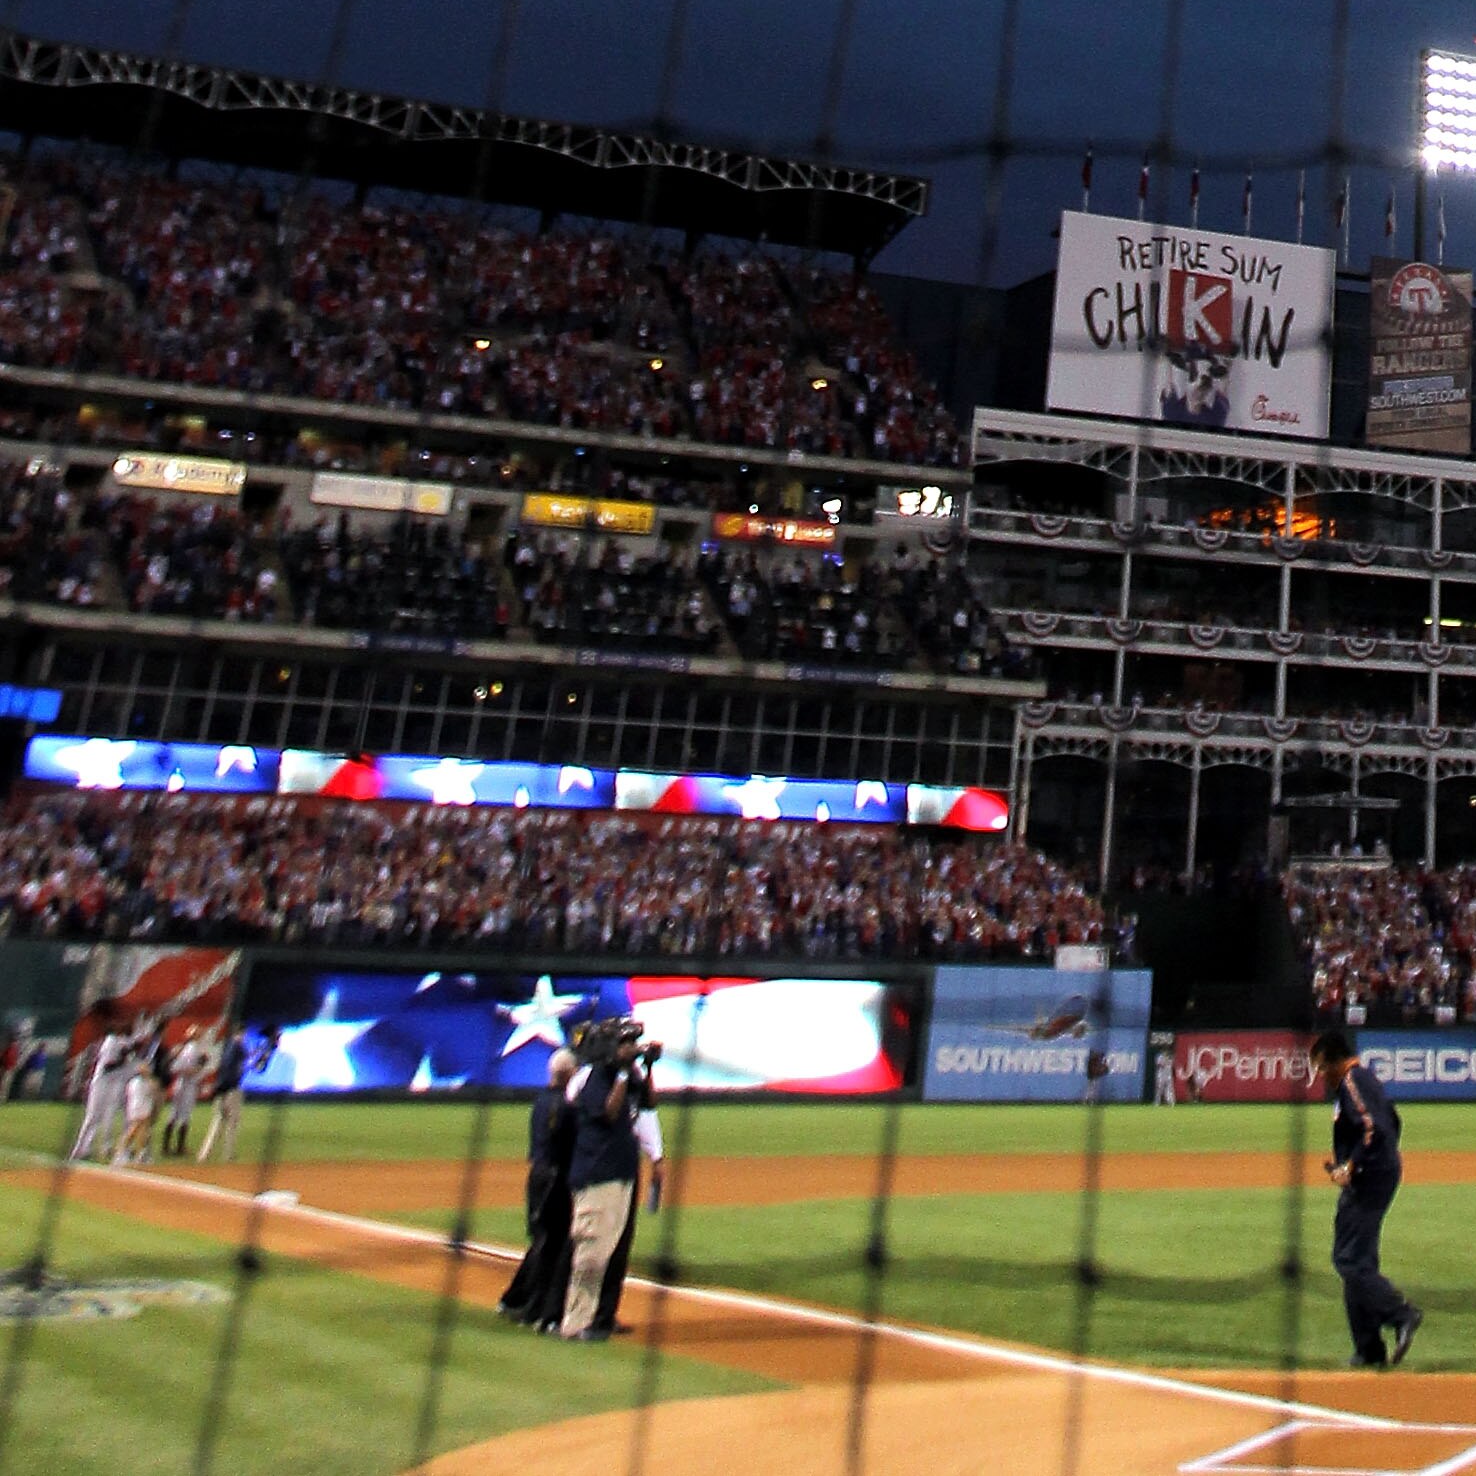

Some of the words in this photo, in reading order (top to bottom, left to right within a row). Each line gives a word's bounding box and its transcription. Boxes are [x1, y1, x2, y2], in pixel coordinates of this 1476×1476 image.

[1116, 235, 1211, 273] RETIRE
[1219, 245, 1283, 292] SUM
[1084, 276, 1295, 370] CHIKIN
[1177, 1046, 1319, 1089] JCPenney
